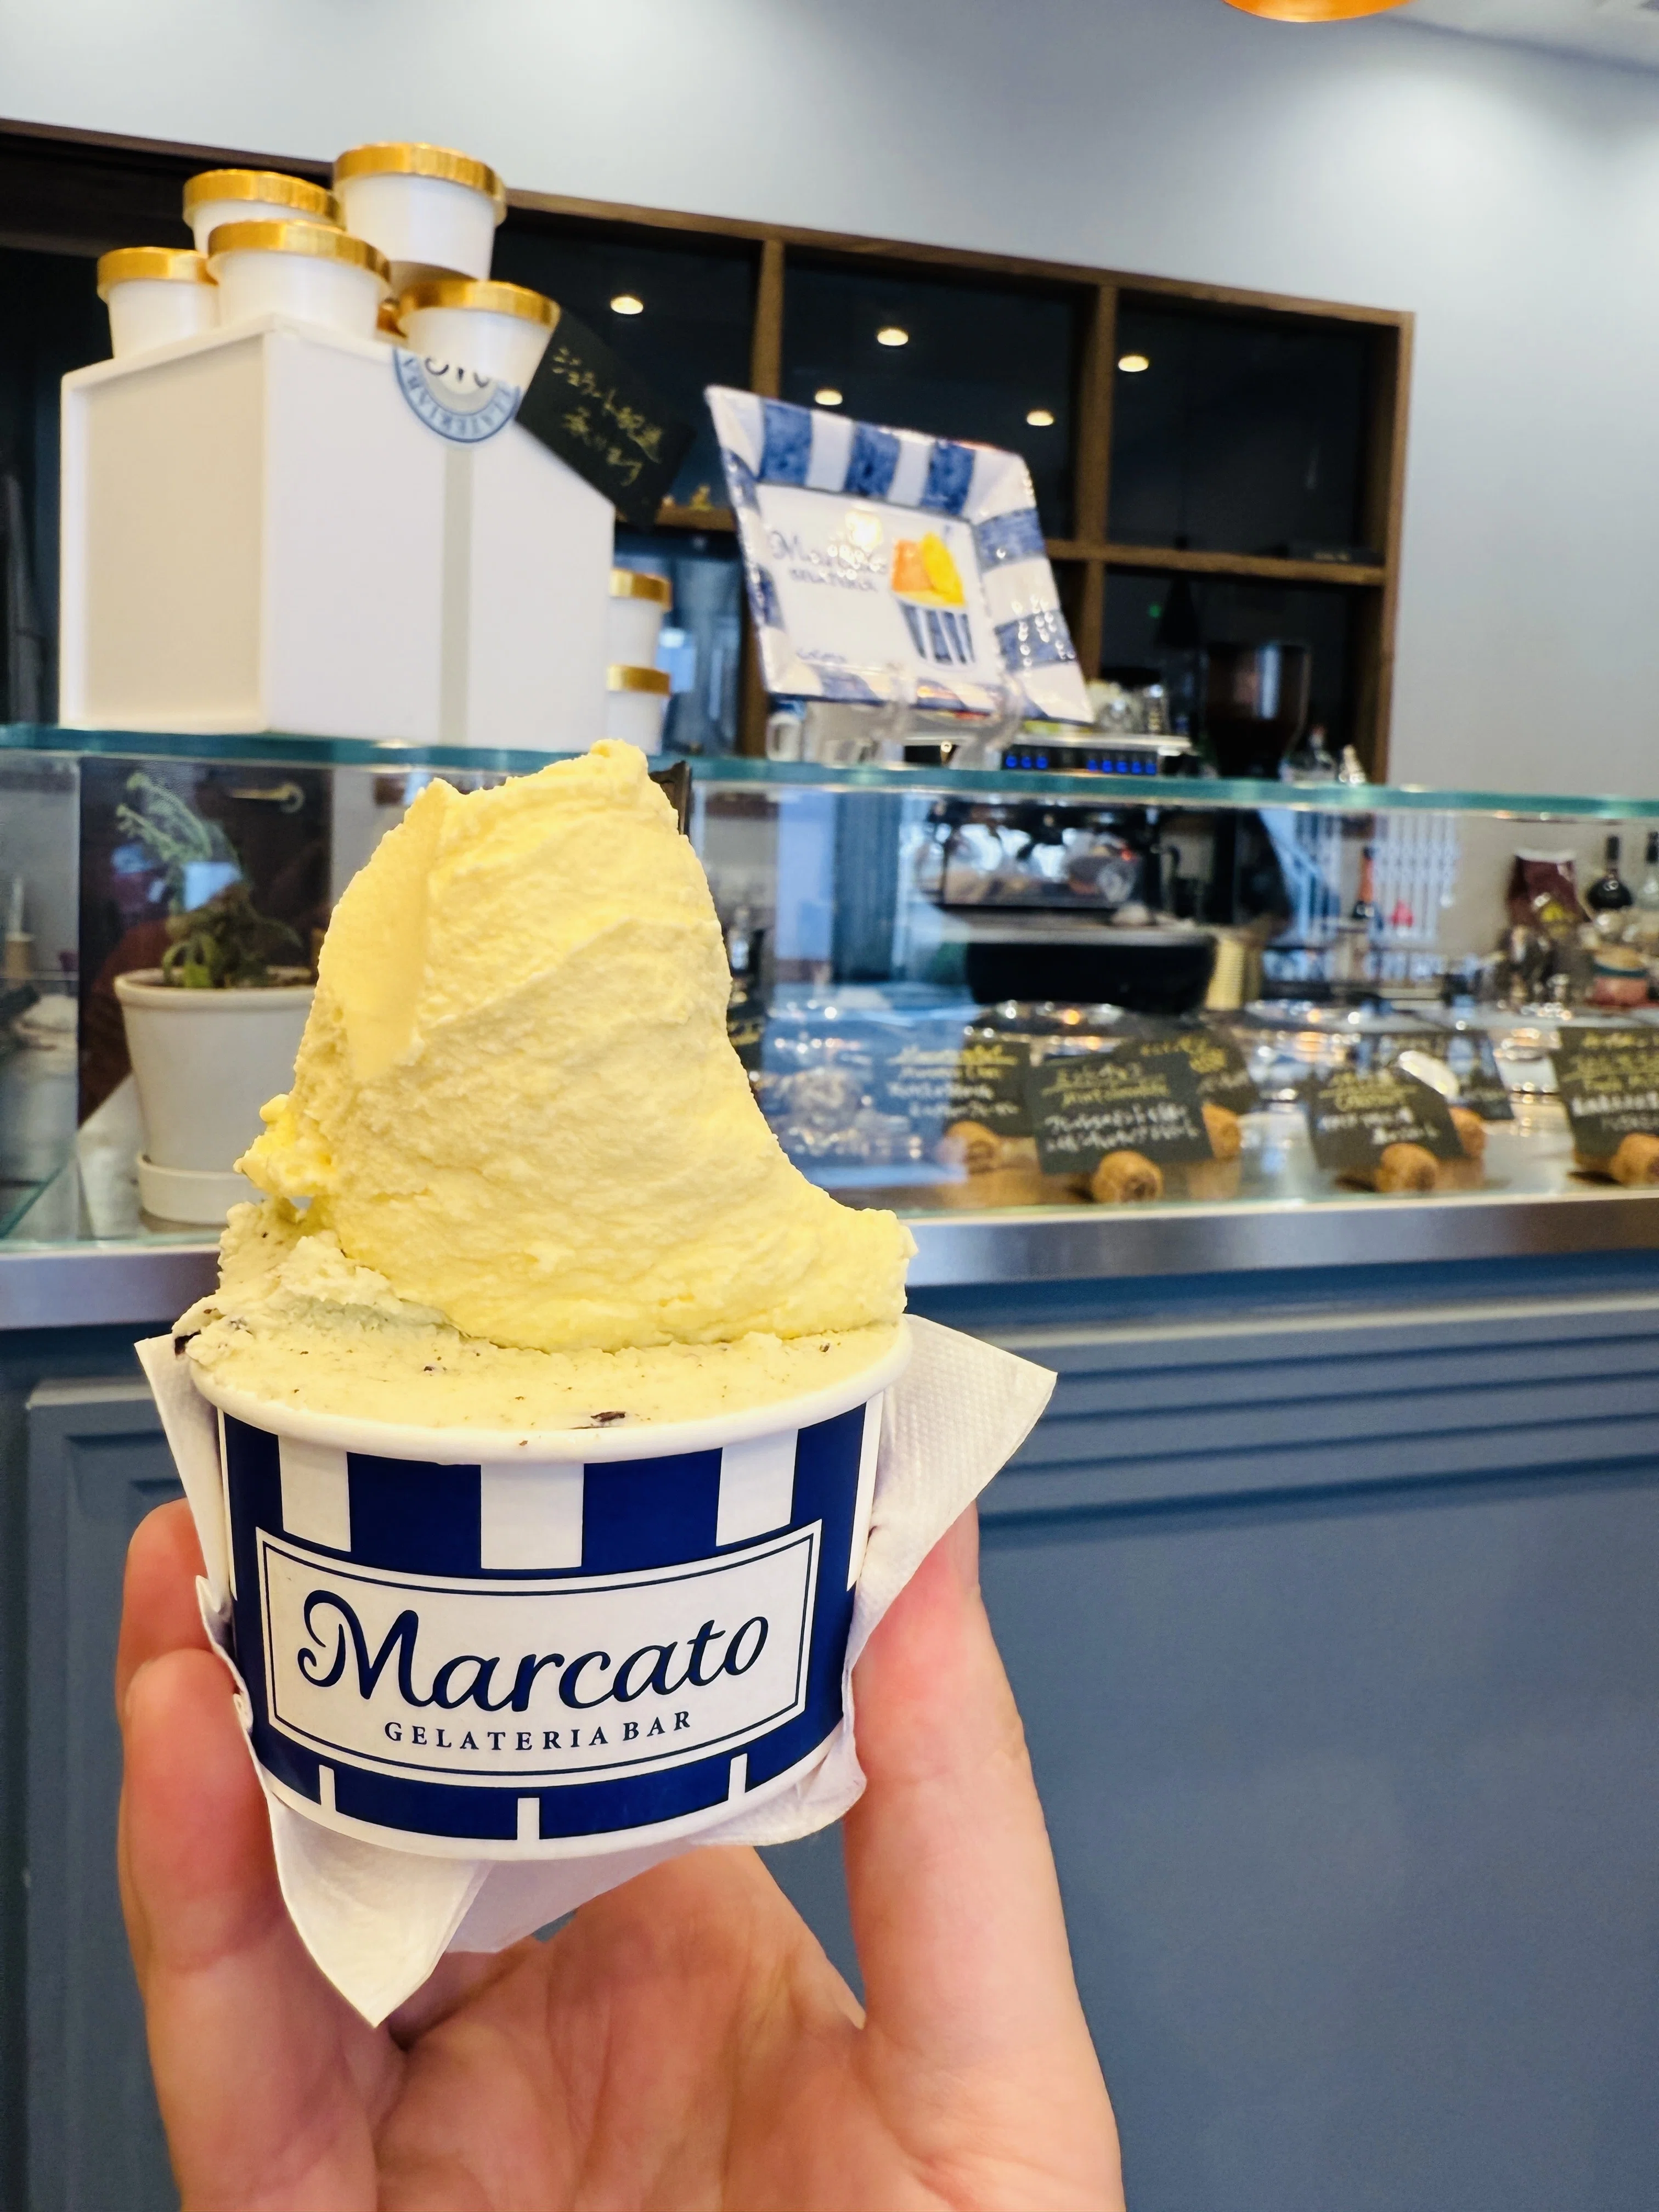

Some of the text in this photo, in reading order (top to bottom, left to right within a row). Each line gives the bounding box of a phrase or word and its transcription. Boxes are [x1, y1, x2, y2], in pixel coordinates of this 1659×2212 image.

[297, 1589, 769, 1712] Marcato
[385, 1711, 690, 1751] GELATERIA BAR
